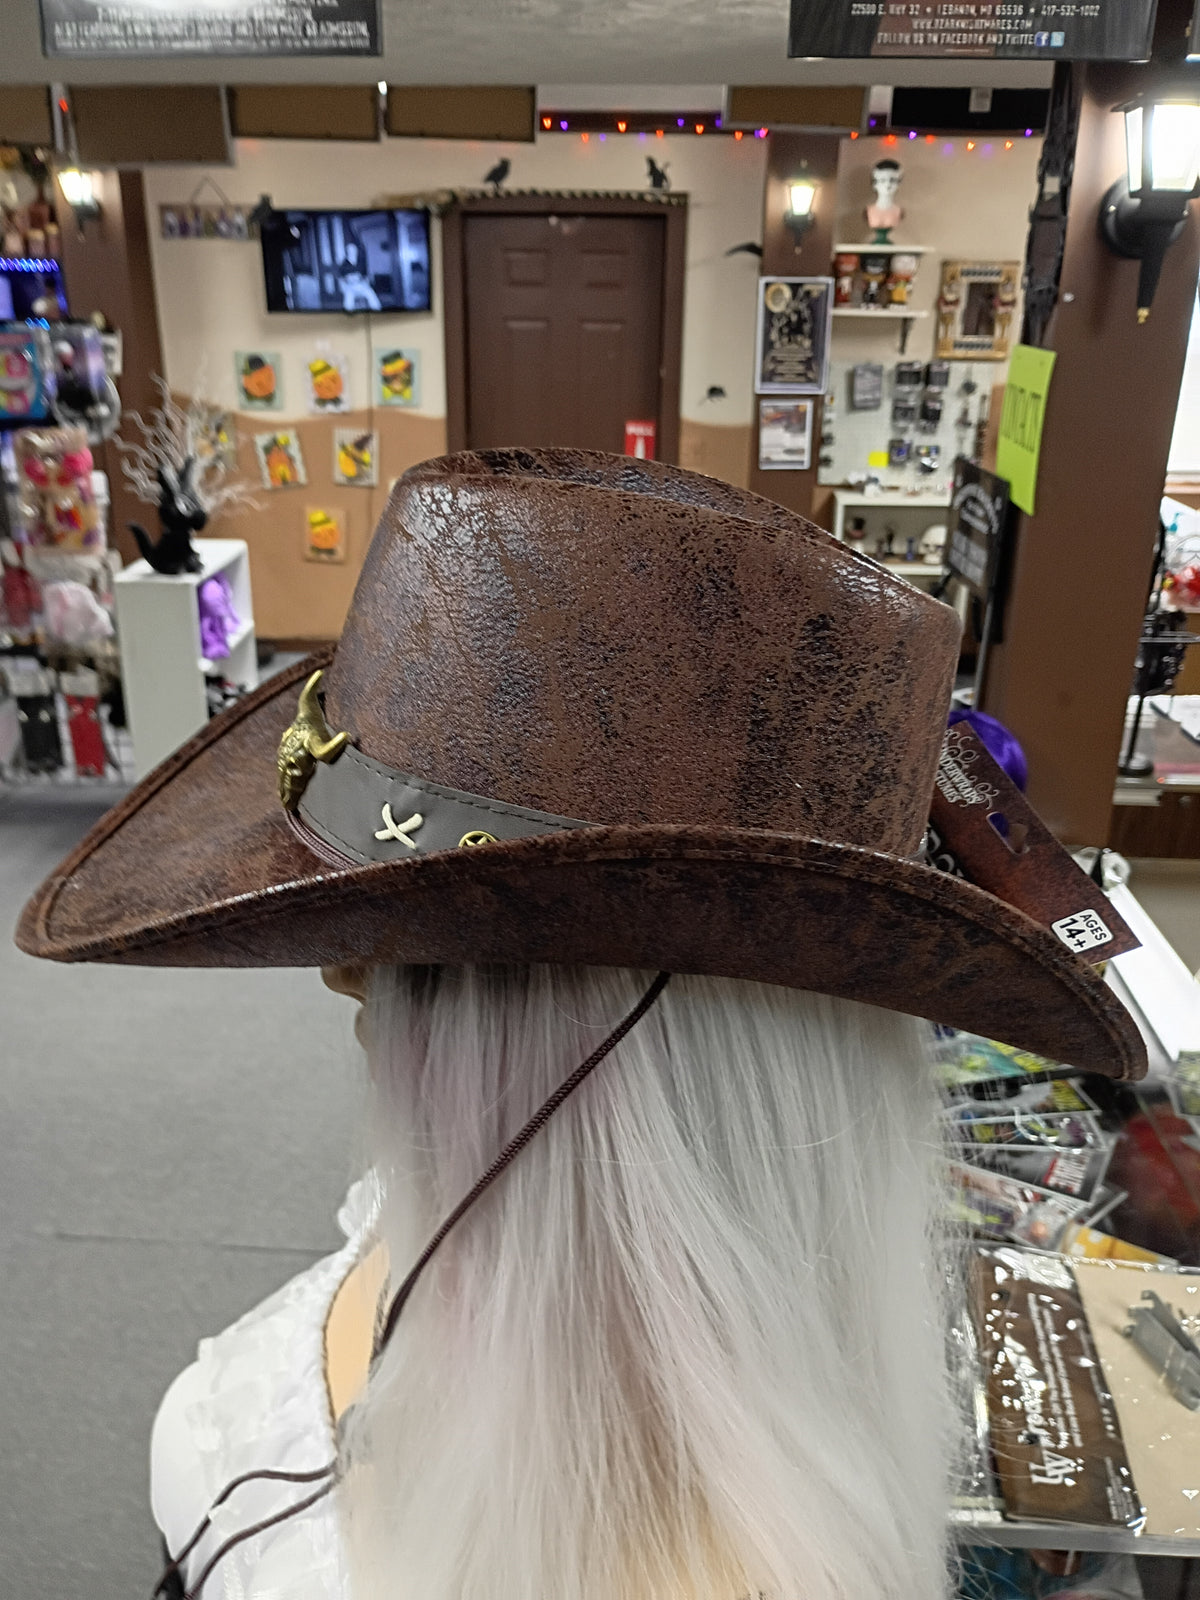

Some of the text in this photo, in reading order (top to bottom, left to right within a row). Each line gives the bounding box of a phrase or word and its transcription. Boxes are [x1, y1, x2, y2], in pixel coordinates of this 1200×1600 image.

[908, 4, 920, 15] 32
[995, 5, 1024, 16] 65536
[877, 32, 911, 44] FOLLOW
[913, 33, 925, 45] US
[927, 33, 938, 45] ON
[940, 33, 984, 45] FACEBOOK
[986, 33, 1002, 45] AND
[1005, 33, 1035, 45] TWITTE
[940, 748, 980, 804] NDERWRAPS
[1059, 917, 1086, 949] 14+
[1080, 913, 1107, 941] AGES
